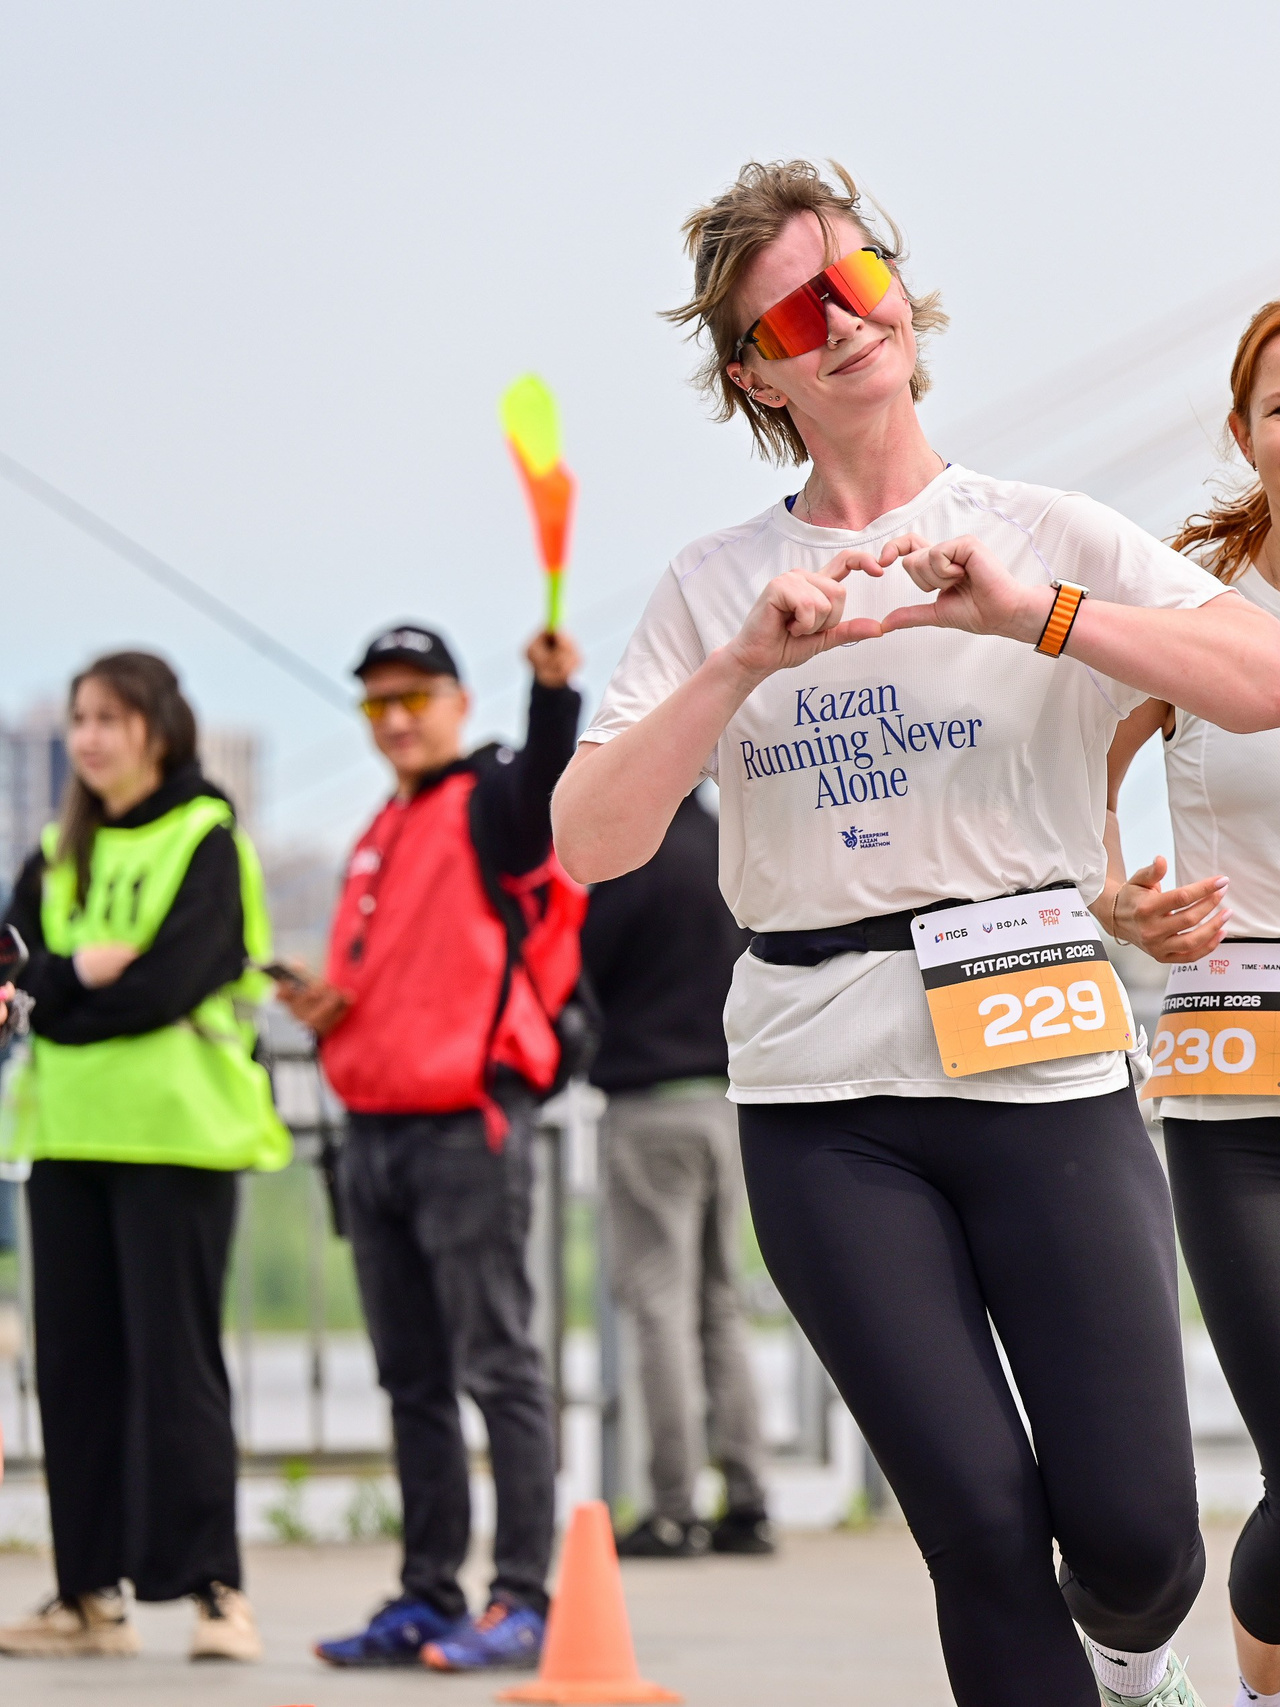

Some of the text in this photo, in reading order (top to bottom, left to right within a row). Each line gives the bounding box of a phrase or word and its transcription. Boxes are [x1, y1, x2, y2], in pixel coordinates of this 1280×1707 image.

[794, 684, 900, 727] Kazan
[740, 714, 982, 780] Running Never
[815, 766, 908, 809] Alone
[860, 841, 891, 849] MARATHON
[945, 918, 1028, 941] ПСБ ВФЛА
[1038, 908, 1061, 919] ЭТНО
[961, 944, 1095, 977] ТАТАРСТАН 2026
[1208, 959, 1230, 968] ЭТНО
[977, 979, 1106, 1047] 229
[1223, 995, 1262, 1007] 2026
[1152, 1027, 1256, 1077] 230
